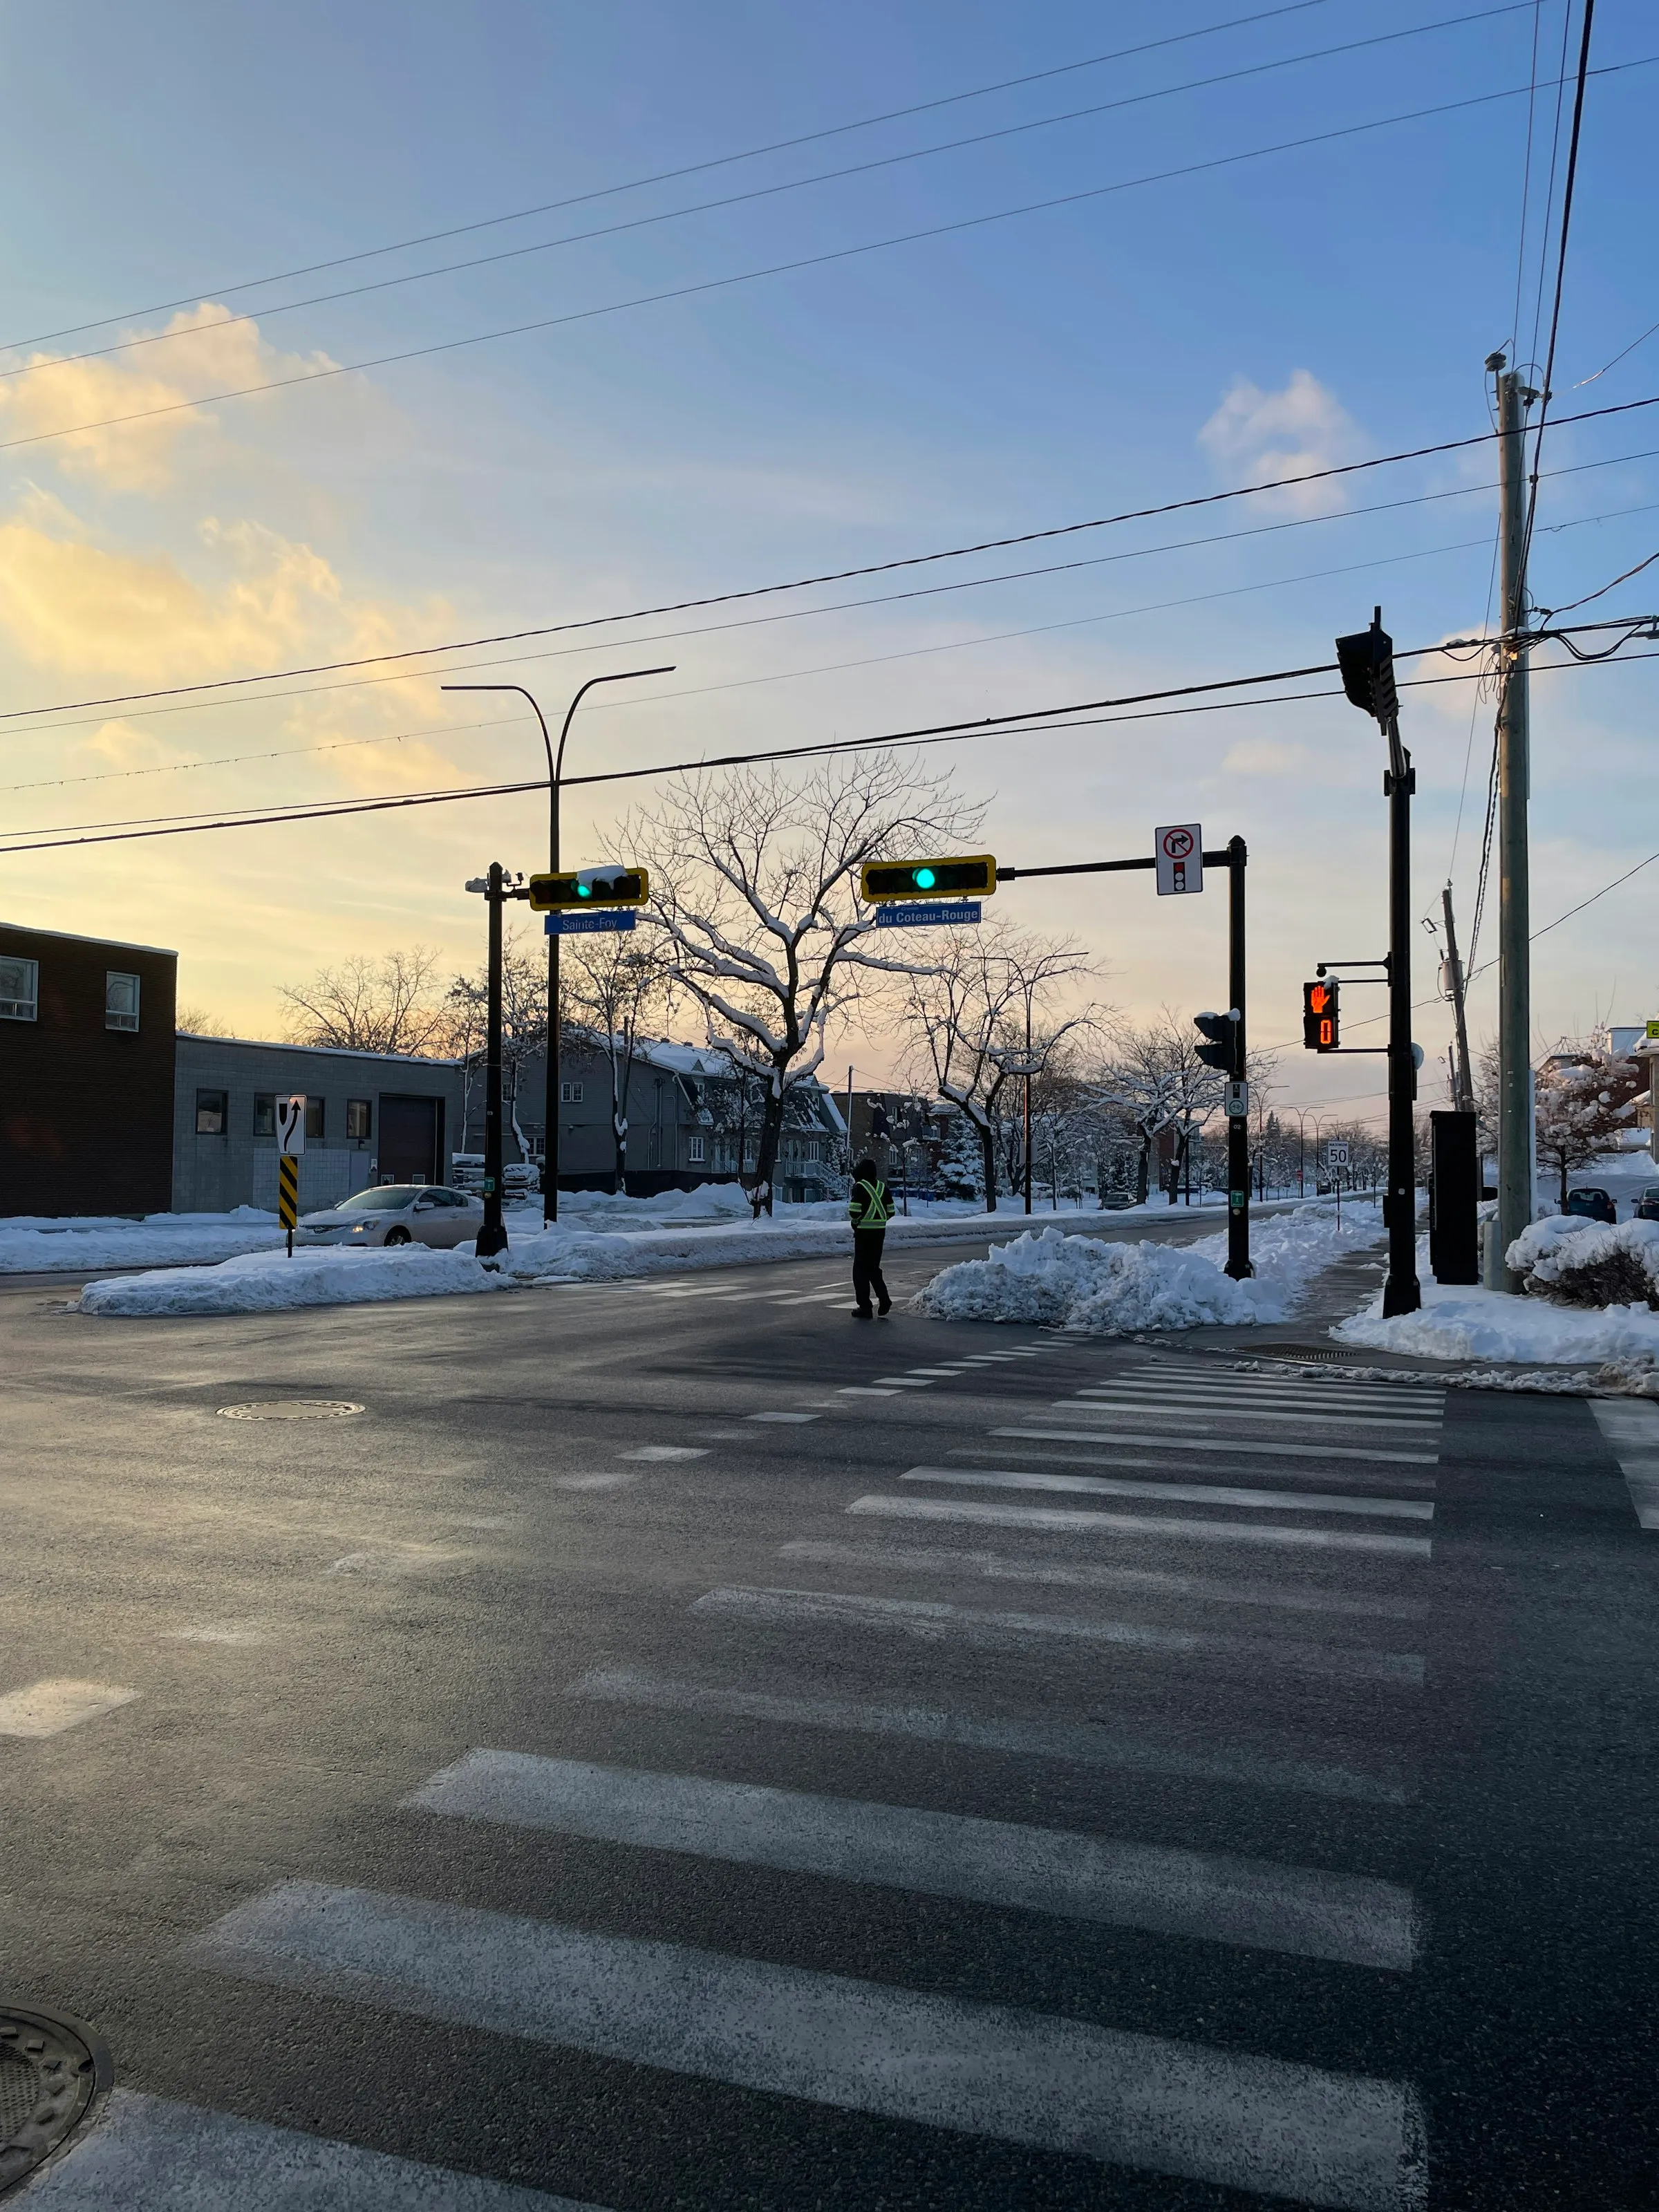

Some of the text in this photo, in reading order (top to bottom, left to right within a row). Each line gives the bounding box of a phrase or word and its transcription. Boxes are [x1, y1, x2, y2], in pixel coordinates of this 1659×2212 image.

[879, 909, 978, 924] du Coteau-Rouge
[562, 917, 617, 931] Sainte-Foy
[1330, 1149, 1347, 1163] 50
